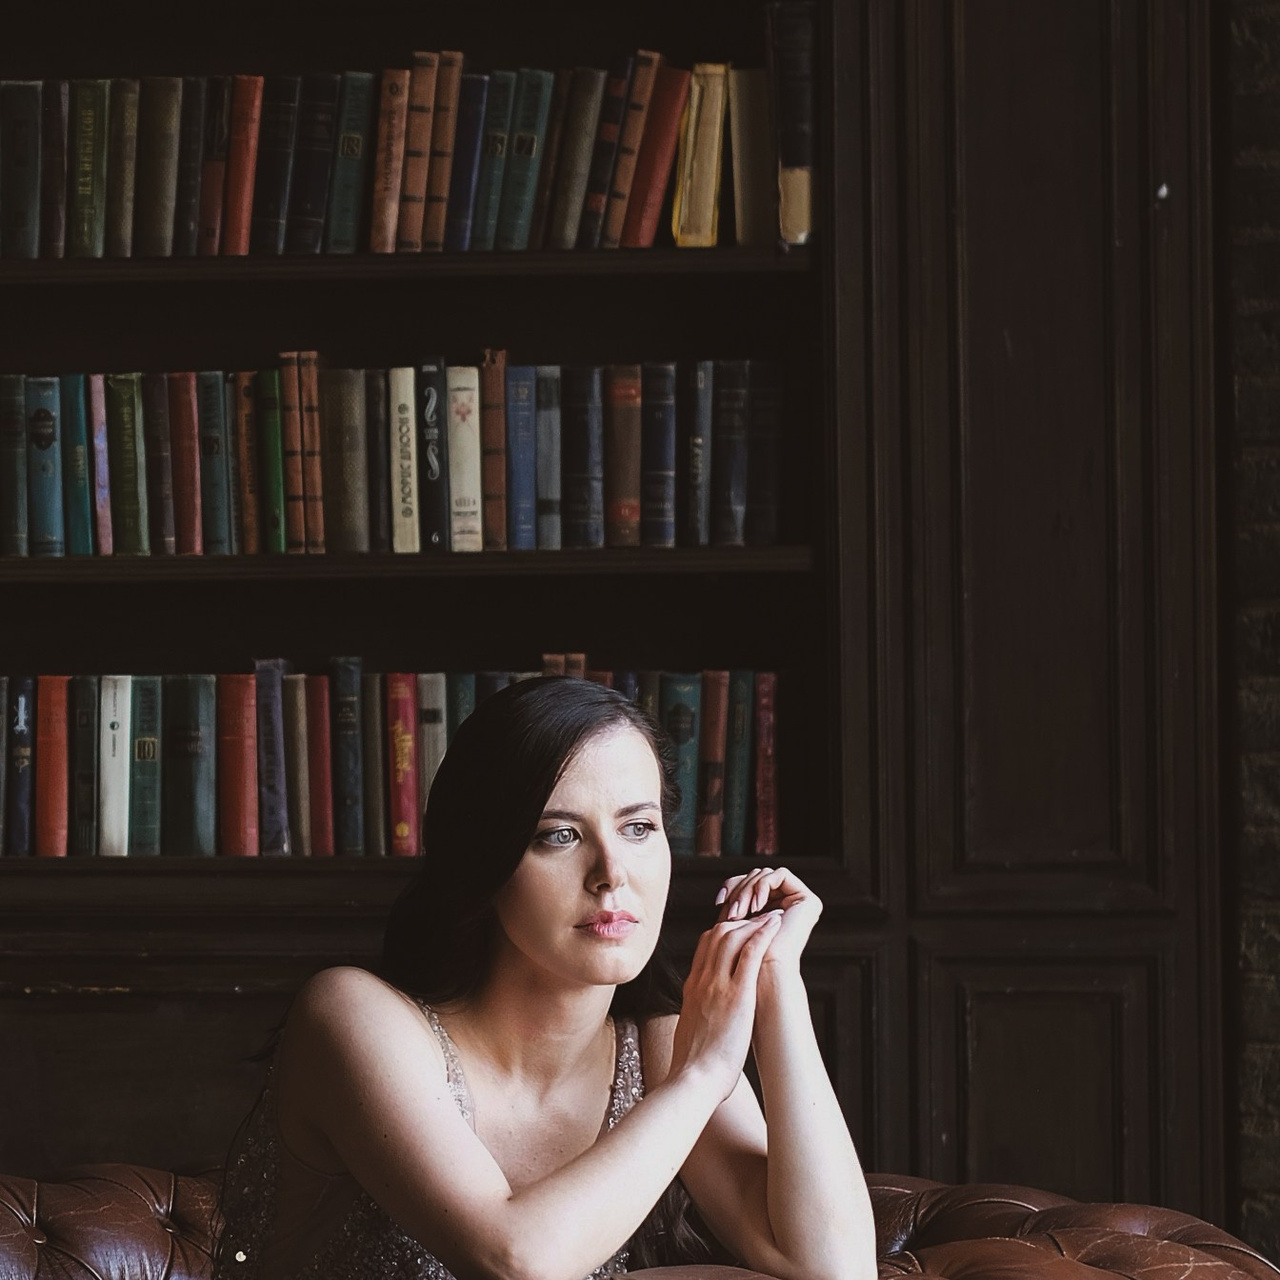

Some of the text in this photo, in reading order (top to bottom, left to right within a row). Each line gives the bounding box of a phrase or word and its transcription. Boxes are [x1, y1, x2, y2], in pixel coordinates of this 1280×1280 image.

[398, 417, 413, 505] МОРИС ДРЮОН
[431, 533, 439, 543] 6
